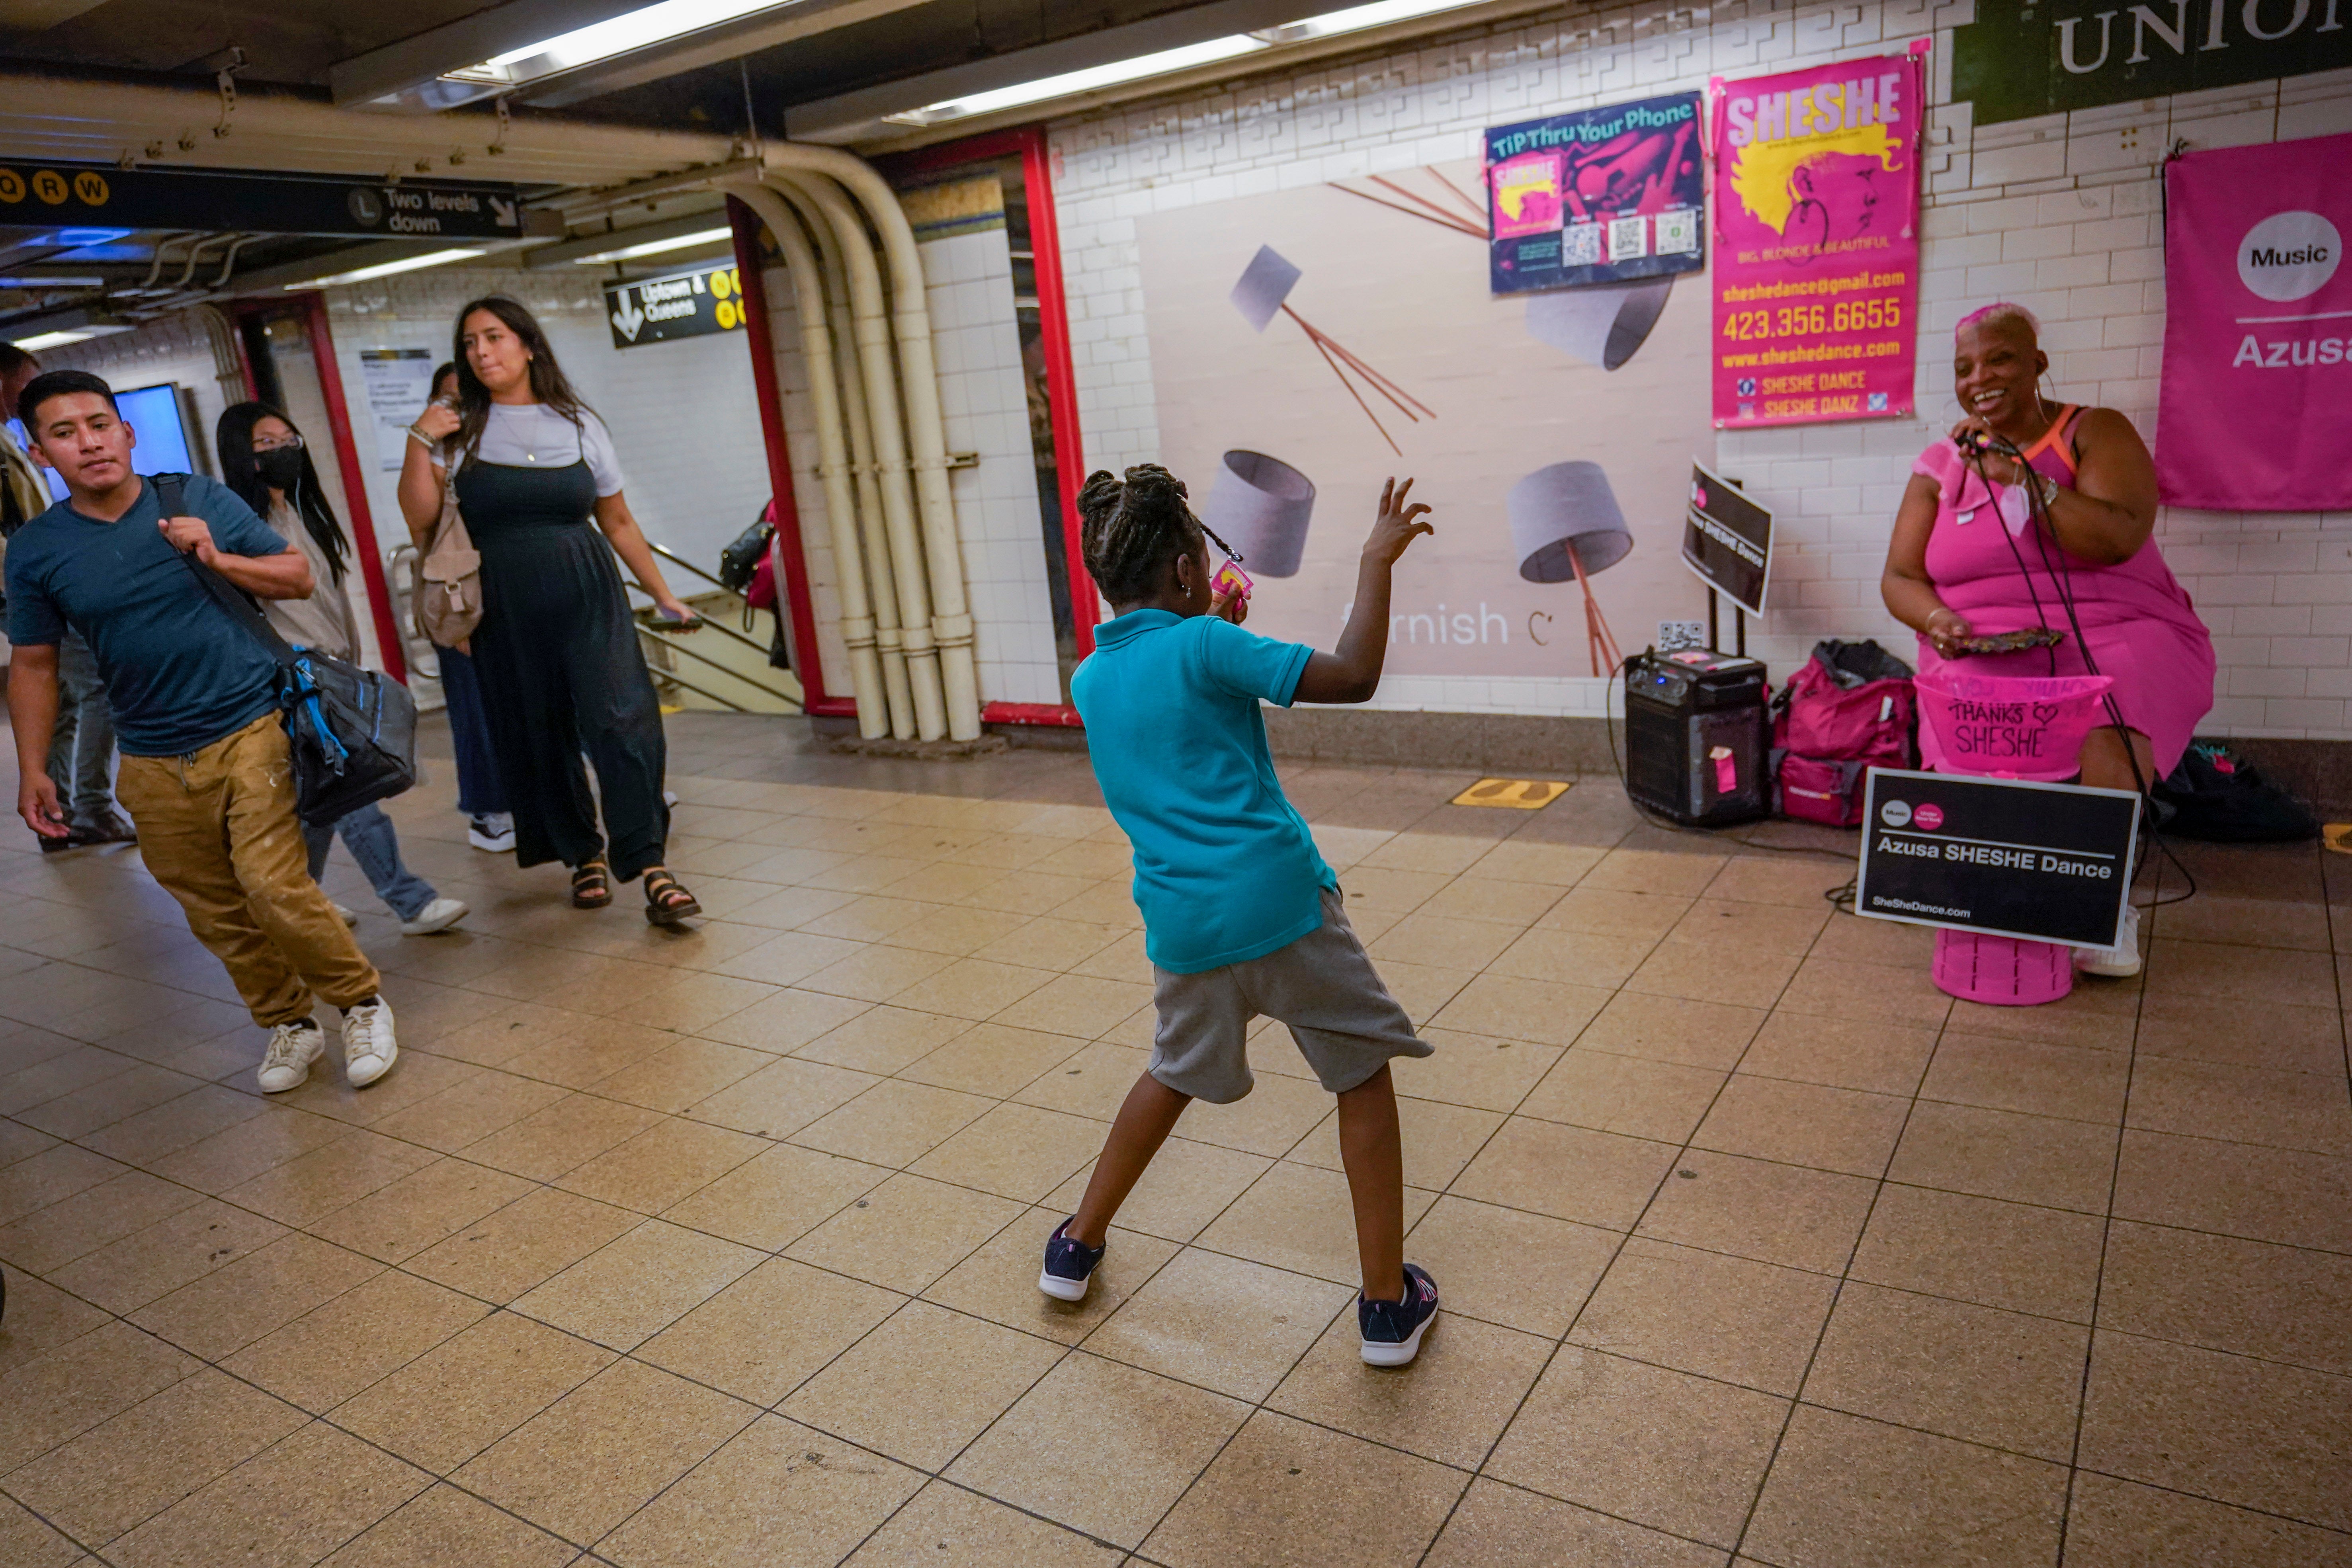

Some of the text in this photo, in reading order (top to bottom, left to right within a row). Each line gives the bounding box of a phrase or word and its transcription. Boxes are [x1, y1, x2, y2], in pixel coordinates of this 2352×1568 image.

[2054, 0, 2343, 74] UNIO
[1727, 72, 1901, 147] SHESHE
[1526, 126, 1575, 148] Thru
[1577, 118, 1623, 142] Your
[1625, 103, 1693, 129] Phone
[41, 178, 59, 196] R
[80, 180, 102, 198] W
[383, 188, 423, 210] Two
[428, 191, 480, 213] levels
[389, 211, 441, 232] down
[2251, 244, 2328, 268] Music
[1723, 271, 1906, 303] sheshedance@gmail.com
[1723, 297, 1901, 341] 423.356.6655
[1722, 341, 1901, 368] www.sheshedance.com
[2232, 334, 2352, 368] Azus
[1762, 370, 1866, 395] SHESHE DANCE
[1764, 398, 1817, 418] SHESHE
[1948, 698, 2023, 724] THANKS
[1955, 725, 2048, 757] SHESHE
[1877, 836, 2112, 879] Azusa SHESHE Dance
[1873, 894, 1971, 918] SheSheDance.com
